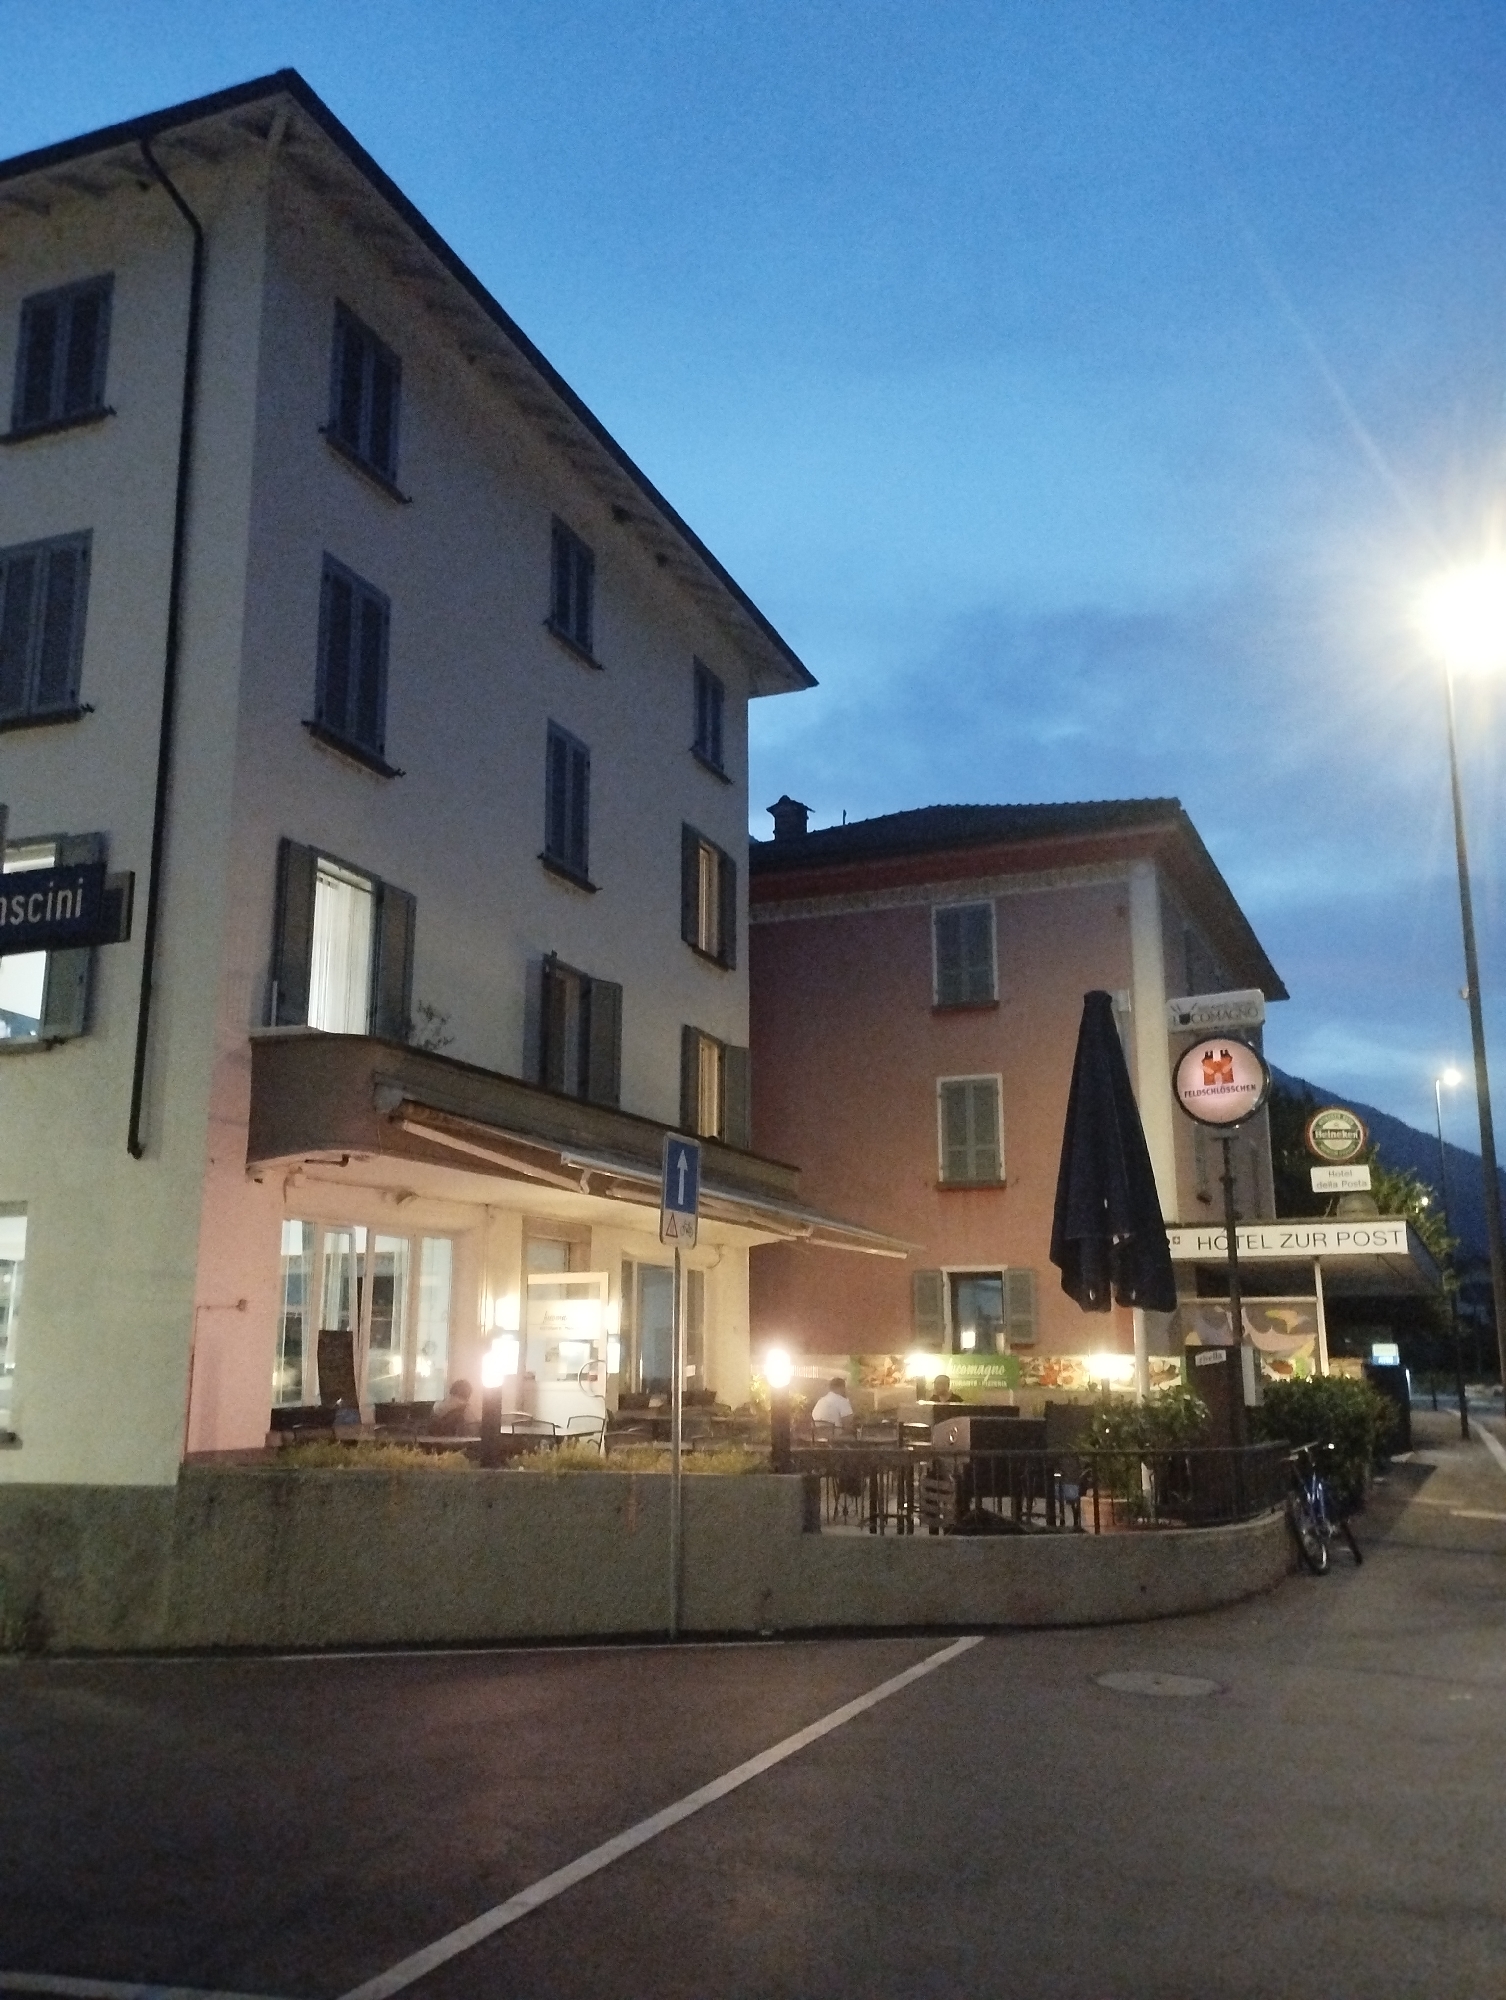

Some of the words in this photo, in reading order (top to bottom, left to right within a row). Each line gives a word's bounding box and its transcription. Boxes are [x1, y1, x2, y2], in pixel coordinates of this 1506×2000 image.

[1184, 1083, 1257, 1099] FELDSCHLÖSSCHEN
[1315, 1128, 1358, 1139] Heineken
[1328, 1169, 1353, 1178] Hotel
[1316, 1180, 1338, 1190] della
[1341, 1179, 1368, 1189] Posta
[1197, 1233, 1273, 1250] HOTEL
[1280, 1232, 1328, 1249] ZUR
[1336, 1229, 1404, 1247] POST
